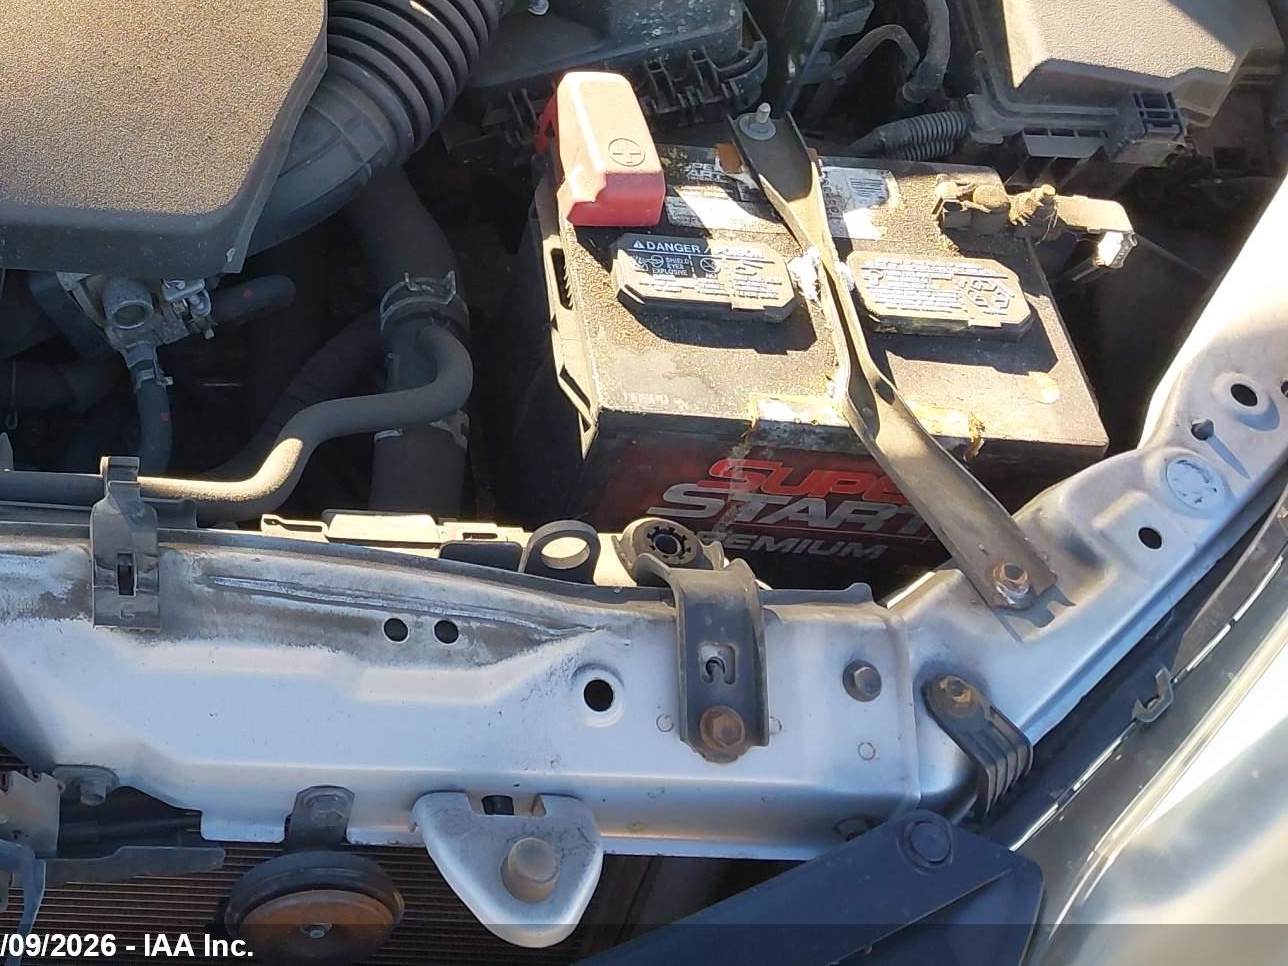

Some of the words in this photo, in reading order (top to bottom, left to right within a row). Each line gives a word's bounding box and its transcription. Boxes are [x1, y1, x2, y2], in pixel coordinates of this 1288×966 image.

[645, 240, 701, 253] DANGER
[665, 257, 690, 265] SHIELD
[696, 457, 910, 503] SUPE
[696, 529, 889, 560] REMIUM
